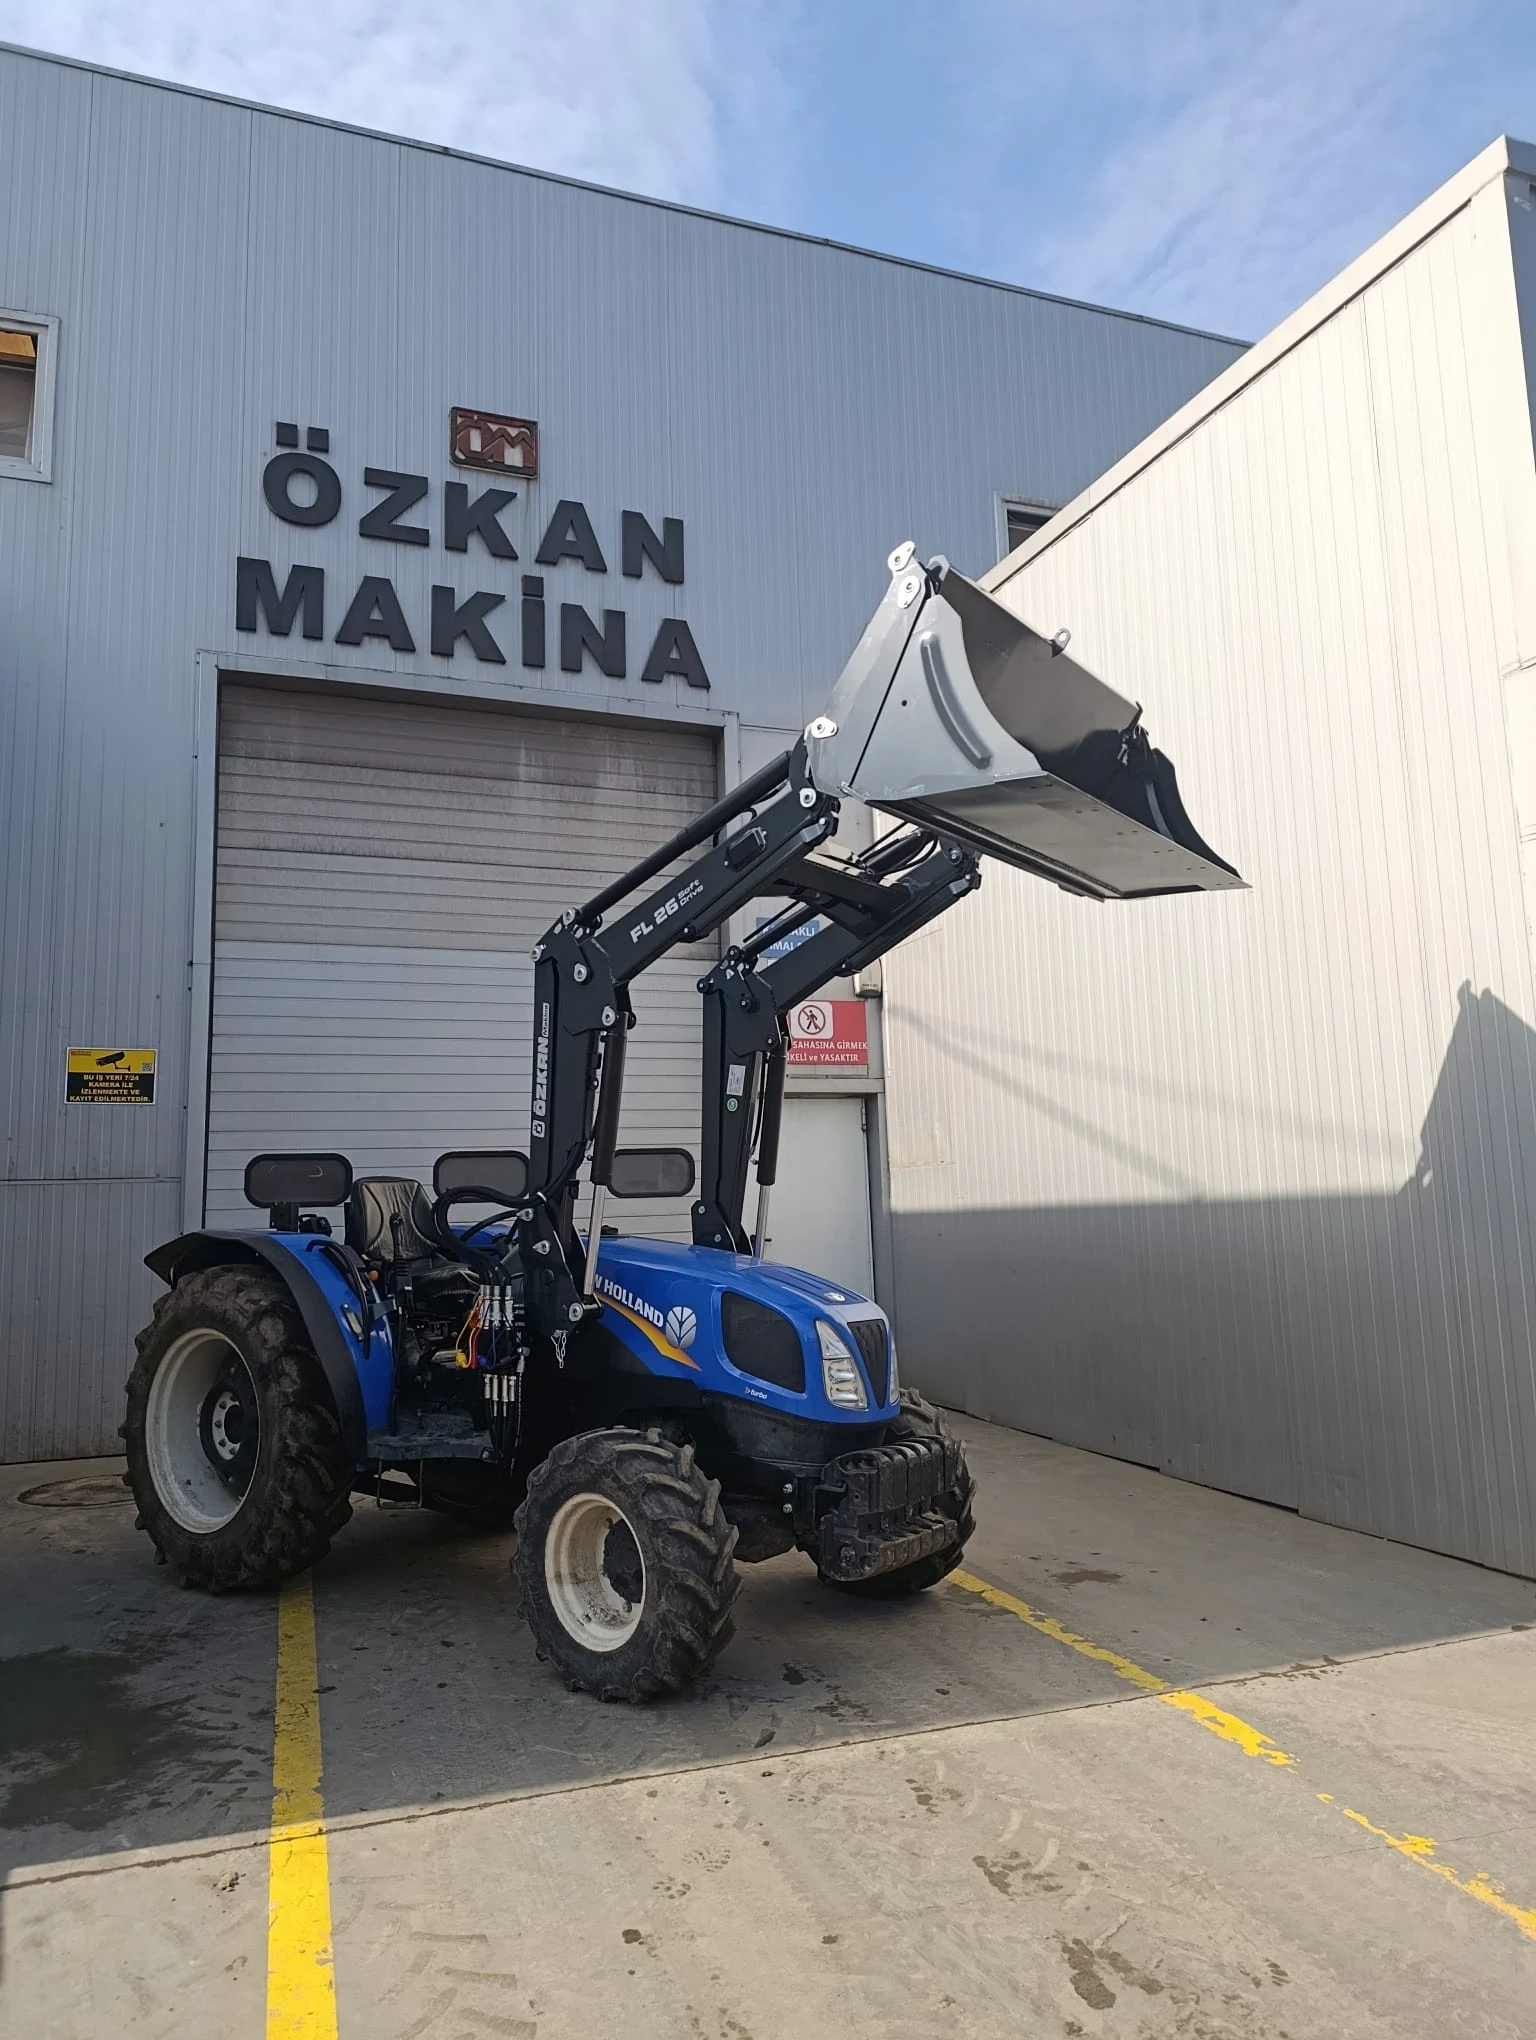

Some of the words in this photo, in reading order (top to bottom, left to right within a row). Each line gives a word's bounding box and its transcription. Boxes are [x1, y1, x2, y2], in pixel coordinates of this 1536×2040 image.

[263, 421, 685, 584] ÖZKAN
[236, 556, 711, 689] MAKİNA
[678, 879, 700, 899] Soft
[680, 885, 704, 906] Drive
[630, 921, 654, 943] FL
[653, 897, 679, 925] 26
[793, 1041, 835, 1049] SAHASINA
[836, 1040, 868, 1049] GİRMEK
[820, 1053, 859, 1062] YASAKTIR
[533, 1036, 549, 1116] ÖZKAN
[603, 1279, 664, 1328] HOLLAND
